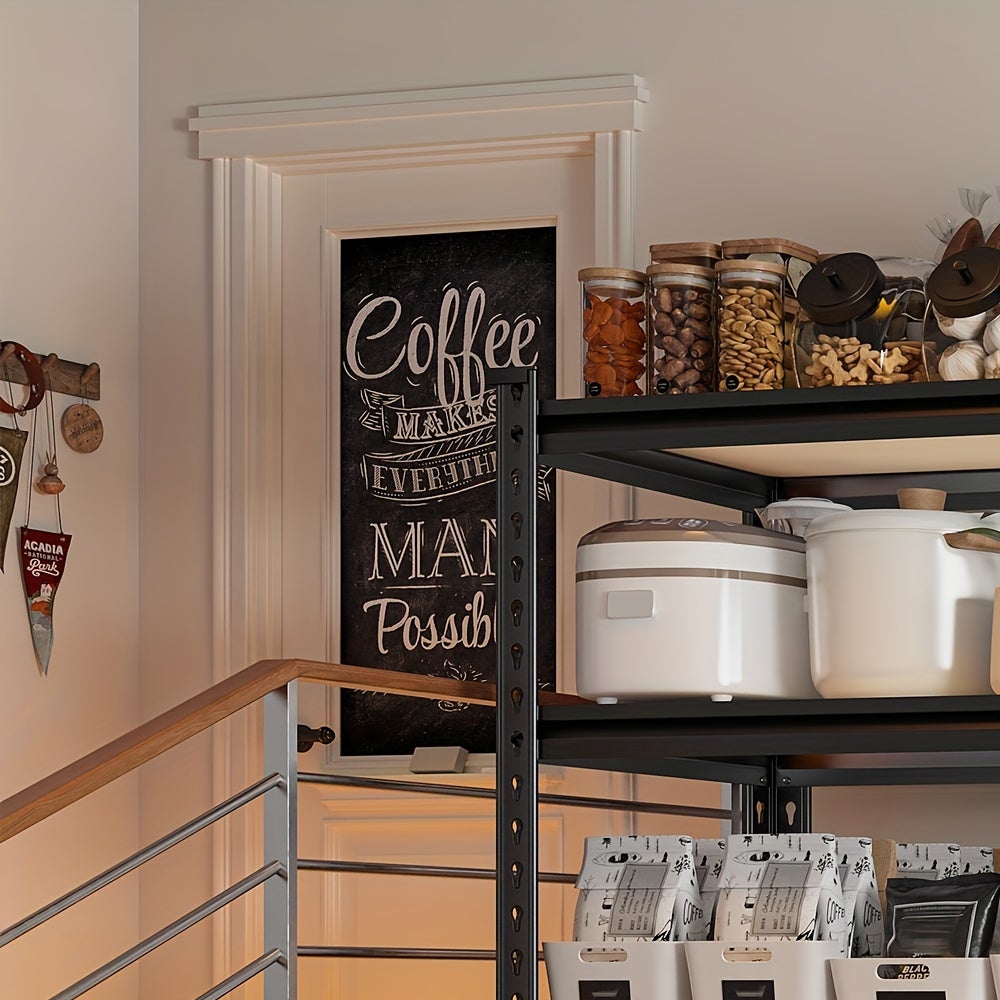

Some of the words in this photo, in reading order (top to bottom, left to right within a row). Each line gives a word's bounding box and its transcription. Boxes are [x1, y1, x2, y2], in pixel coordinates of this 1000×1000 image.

[346, 286, 539, 408] Coffee
[24, 539, 64, 555] ACADIA
[26, 558, 60, 577] Park
[362, 590, 497, 655] Possib
[901, 965, 931, 974] BLAC
